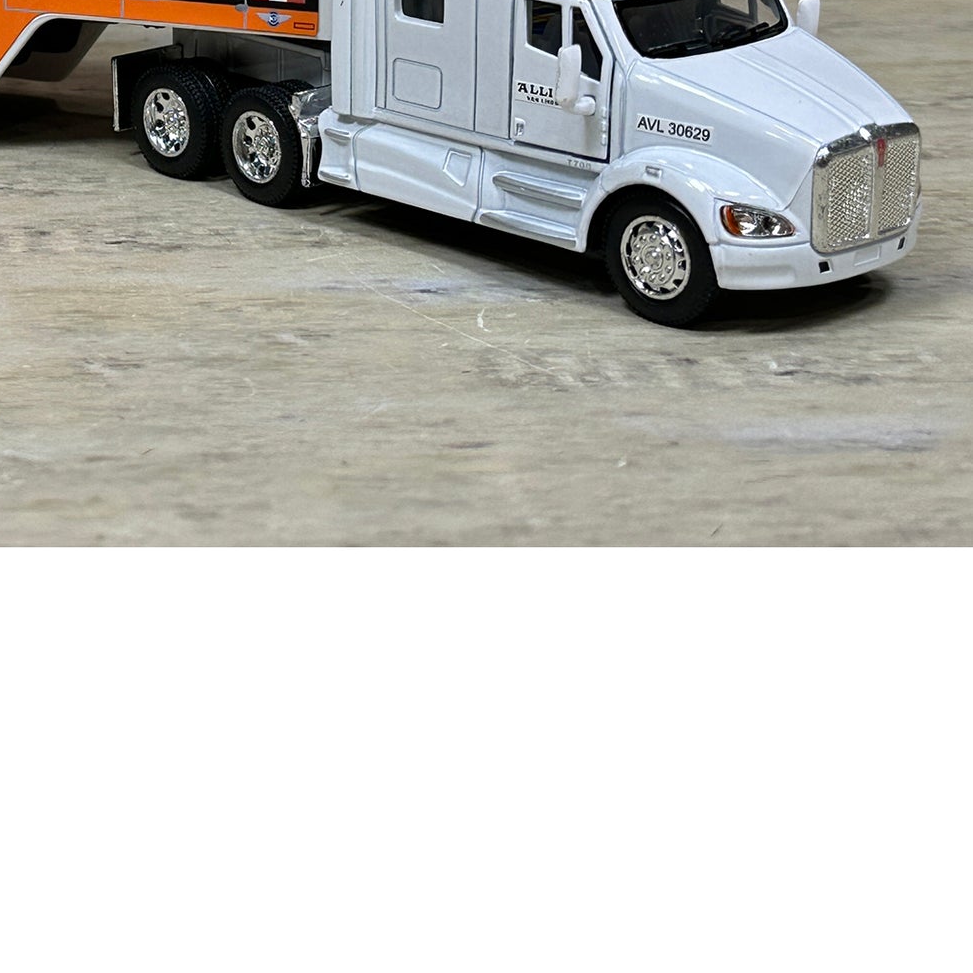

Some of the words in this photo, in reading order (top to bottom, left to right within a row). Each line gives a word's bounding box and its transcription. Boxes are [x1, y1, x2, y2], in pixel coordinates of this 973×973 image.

[517, 82, 554, 98] ALLI
[637, 116, 664, 133] AVL
[668, 122, 711, 142] 30629
